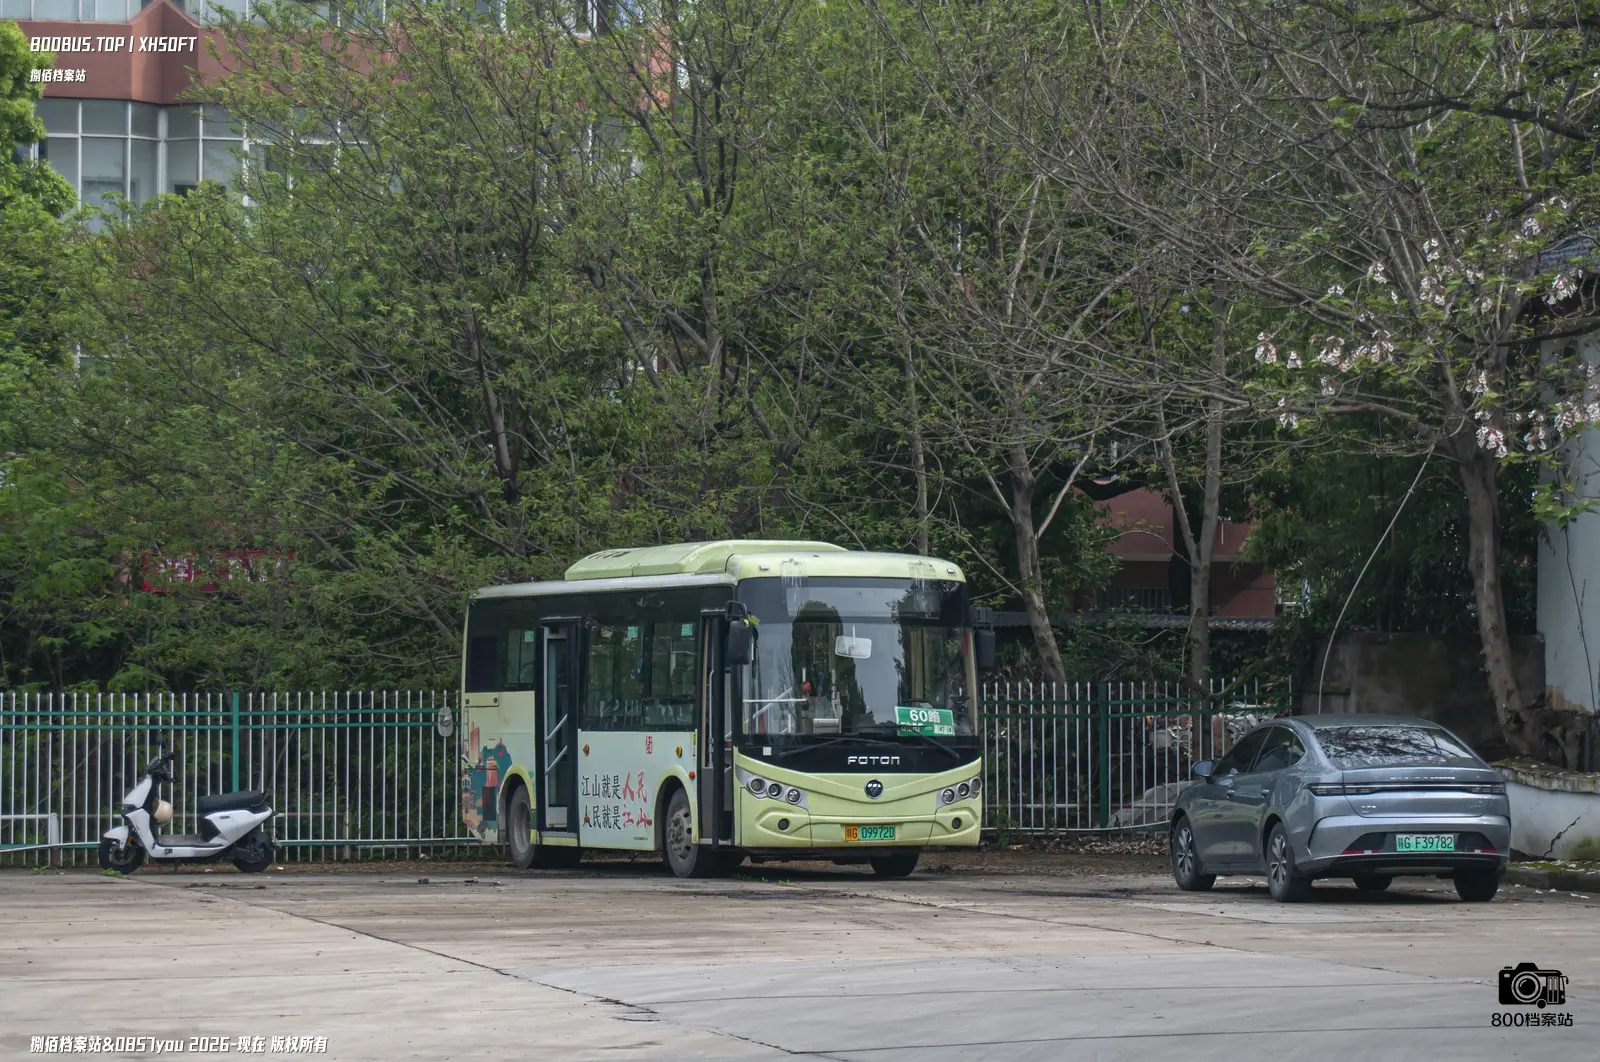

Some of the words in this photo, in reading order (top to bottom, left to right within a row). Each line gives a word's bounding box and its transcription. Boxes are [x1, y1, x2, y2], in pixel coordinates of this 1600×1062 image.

[909, 709, 941, 723] 60路
[847, 756, 901, 765] FOTON
[581, 771, 648, 804] 江山就是人民
[582, 803, 648, 830] 人民就是江山
